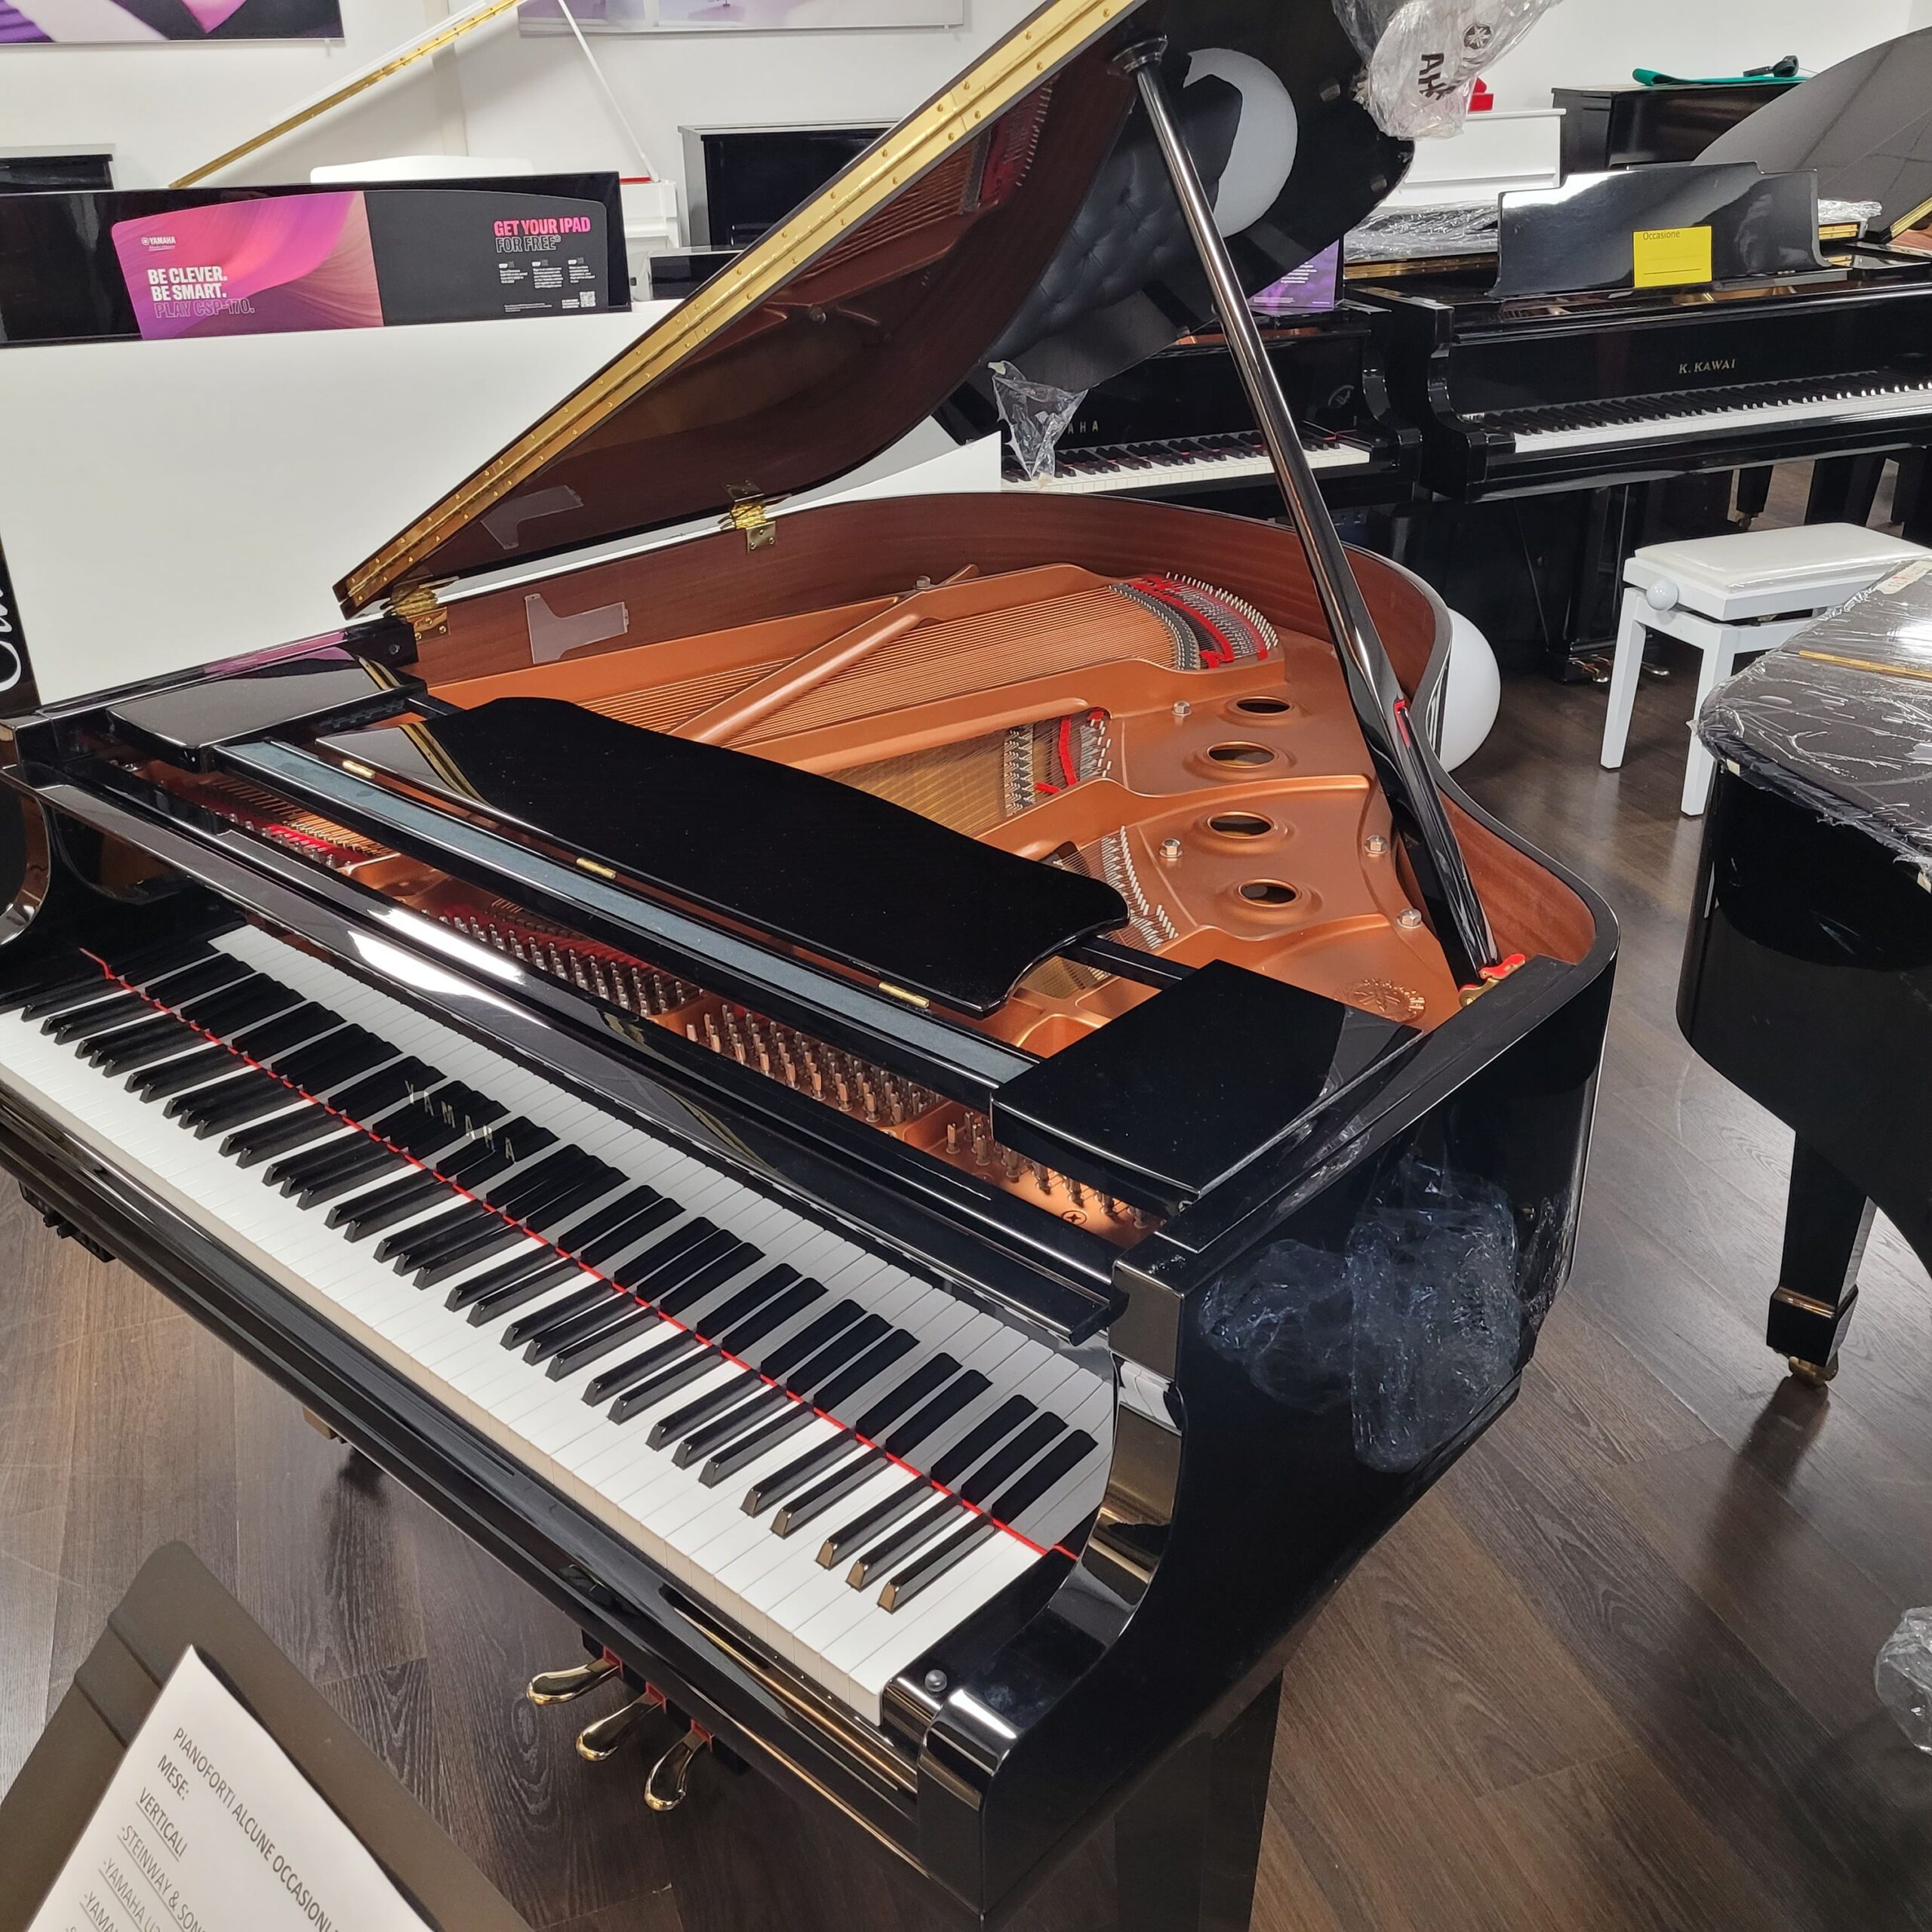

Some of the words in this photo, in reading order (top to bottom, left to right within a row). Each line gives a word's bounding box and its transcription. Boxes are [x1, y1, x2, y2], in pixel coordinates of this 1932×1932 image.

[494, 220, 519, 236] GET
[521, 218, 558, 235] YOUR
[559, 217, 591, 233] IPAD
[1642, 231, 1680, 241] Occasione
[149, 236, 177, 245] YAMAHA
[495, 236, 523, 253] FOR
[147, 268, 168, 285] BE
[168, 266, 228, 284] CLEVER.
[151, 285, 171, 302] BE
[171, 282, 227, 301] SMART.
[154, 301, 191, 318] PLAY
[193, 297, 255, 318] CSP-170.
[1678, 363, 1691, 374] K.
[1694, 358, 1736, 373] KAWAI
[404, 1079, 517, 1164] YAMAHA
[157, 1754, 189, 1801] MESE:
[173, 1726, 236, 1809] PIANOFORTI
[231, 1803, 275, 1861] ALCUNE
[139, 1786, 188, 1857] VERTICALI
[168, 1890, 180, 1911] &
[177, 1903, 205, 1932] SON
